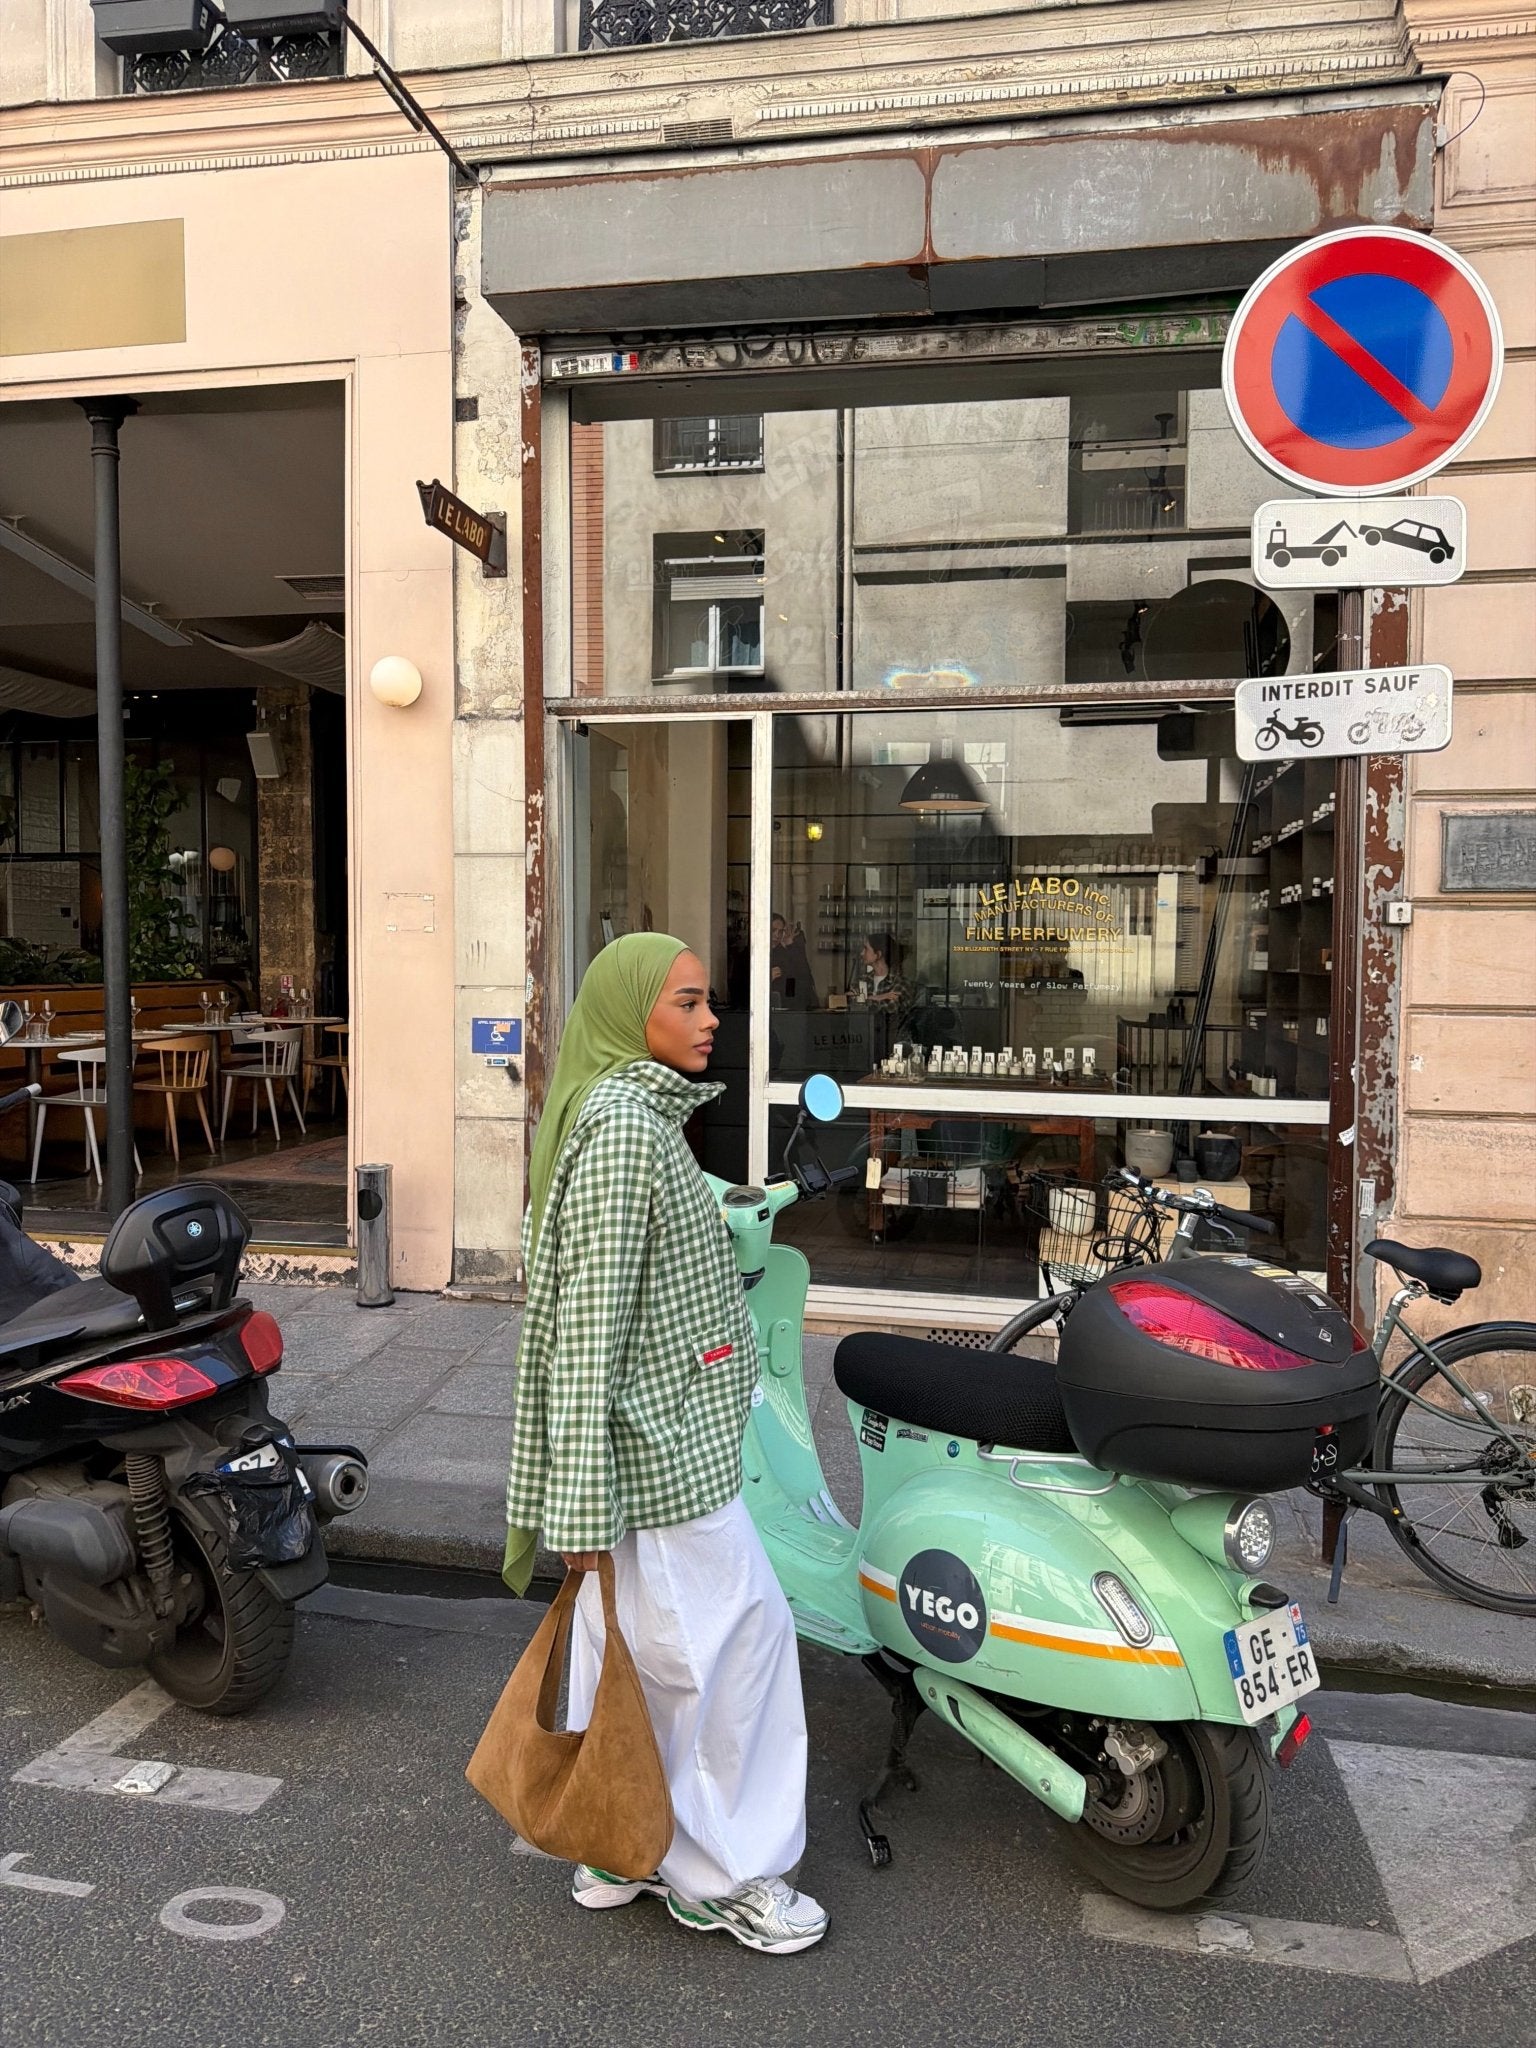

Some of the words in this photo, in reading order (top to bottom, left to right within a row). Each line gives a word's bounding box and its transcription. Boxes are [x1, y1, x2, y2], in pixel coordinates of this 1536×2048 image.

[438, 497, 454, 526] LE
[455, 510, 484, 548] LABO
[1262, 680, 1353, 702] INTERDIT
[1364, 674, 1420, 694] SAUF
[978, 882, 1008, 907] LE
[1014, 877, 1080, 898] LABO
[973, 899, 1093, 923] MANUFACTURERS
[1095, 910, 1116, 924] OF
[965, 927, 1004, 941] FINE
[1010, 927, 1122, 942] PERFUMERY
[963, 979, 994, 989] Twenty
[1000, 980, 1025, 989] Years
[1030, 981, 1040, 989] of
[1046, 981, 1068, 990] Slow
[1073, 982, 1121, 992] Perfumery
[905, 1583, 979, 1630] YEGO
[1296, 1624, 1306, 1642] 75
[1233, 1659, 1240, 1672] F
